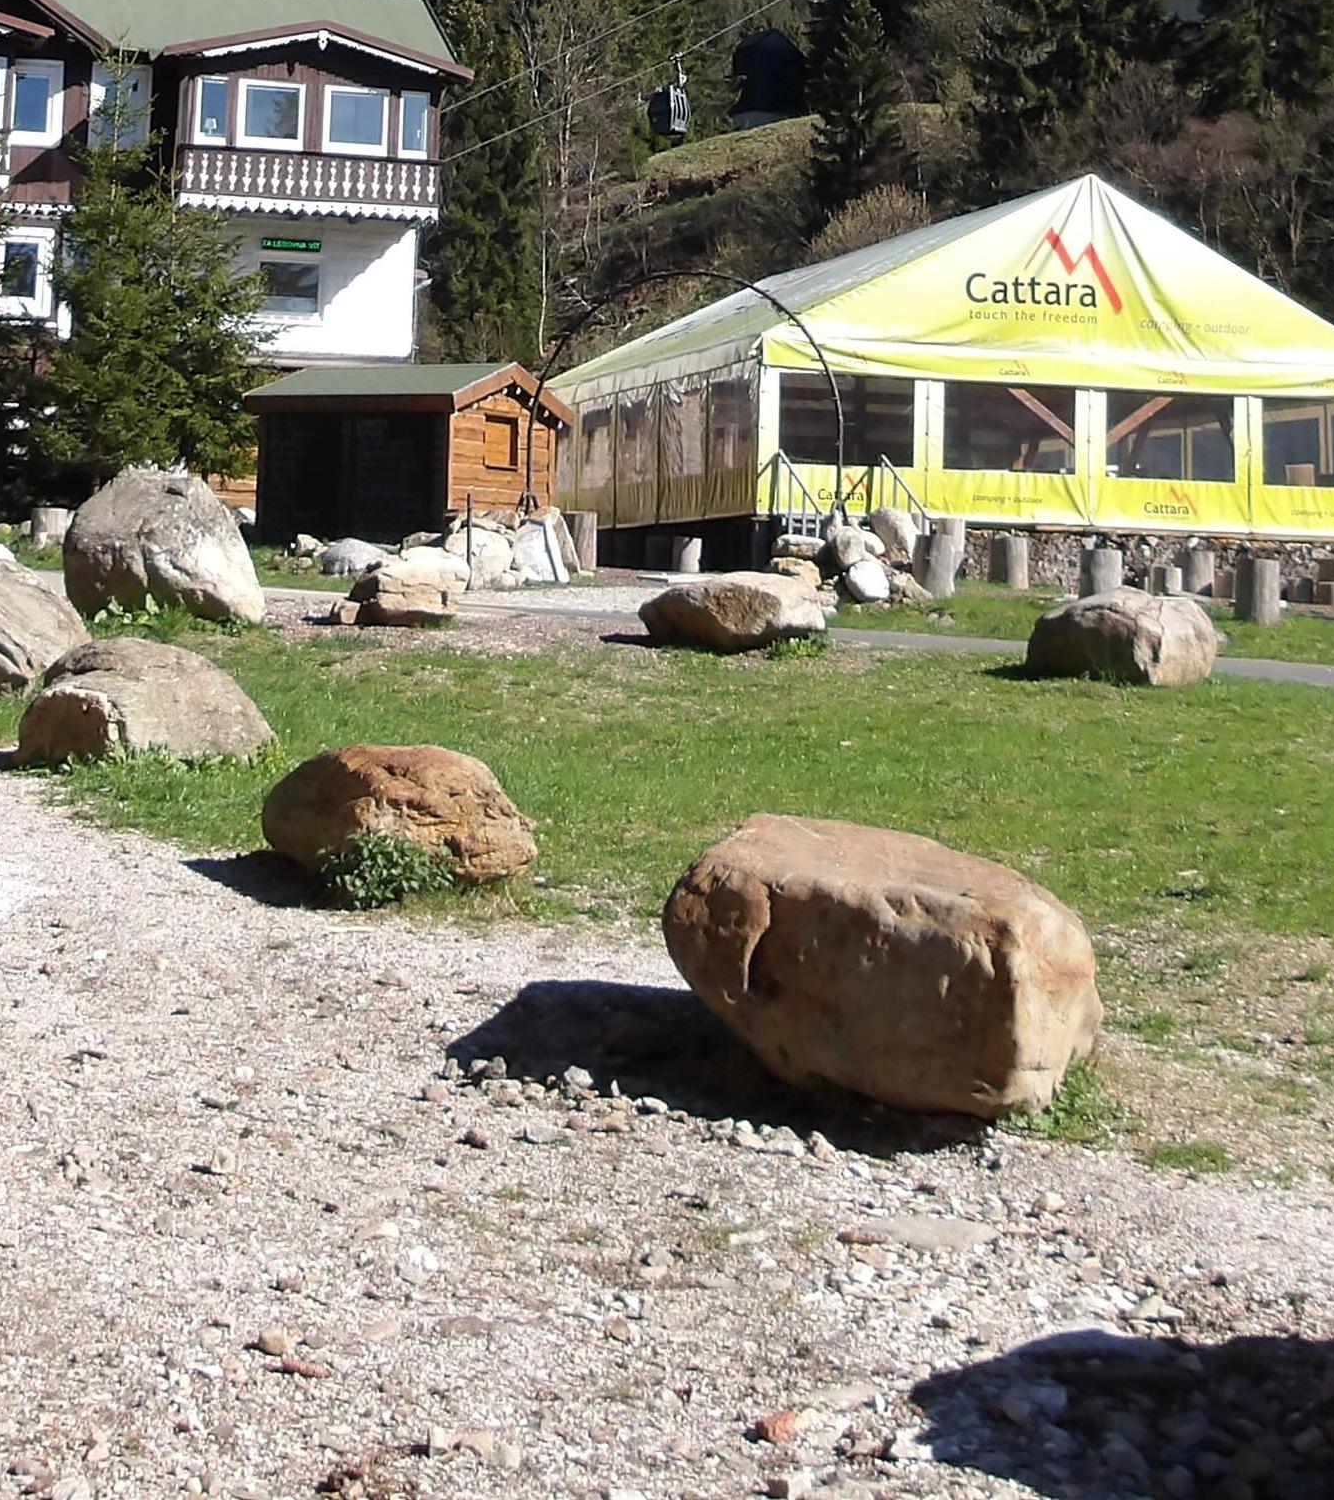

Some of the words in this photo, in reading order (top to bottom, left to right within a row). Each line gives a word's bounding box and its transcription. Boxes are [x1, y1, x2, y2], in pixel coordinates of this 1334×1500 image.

[965, 272, 1097, 309] Cattara
[969, 309, 1008, 320] touch
[1015, 311, 1036, 321] the
[1043, 311, 1098, 324] freedom
[1204, 321, 1251, 335] outdoor
[1144, 502, 1190, 515] Cattara
